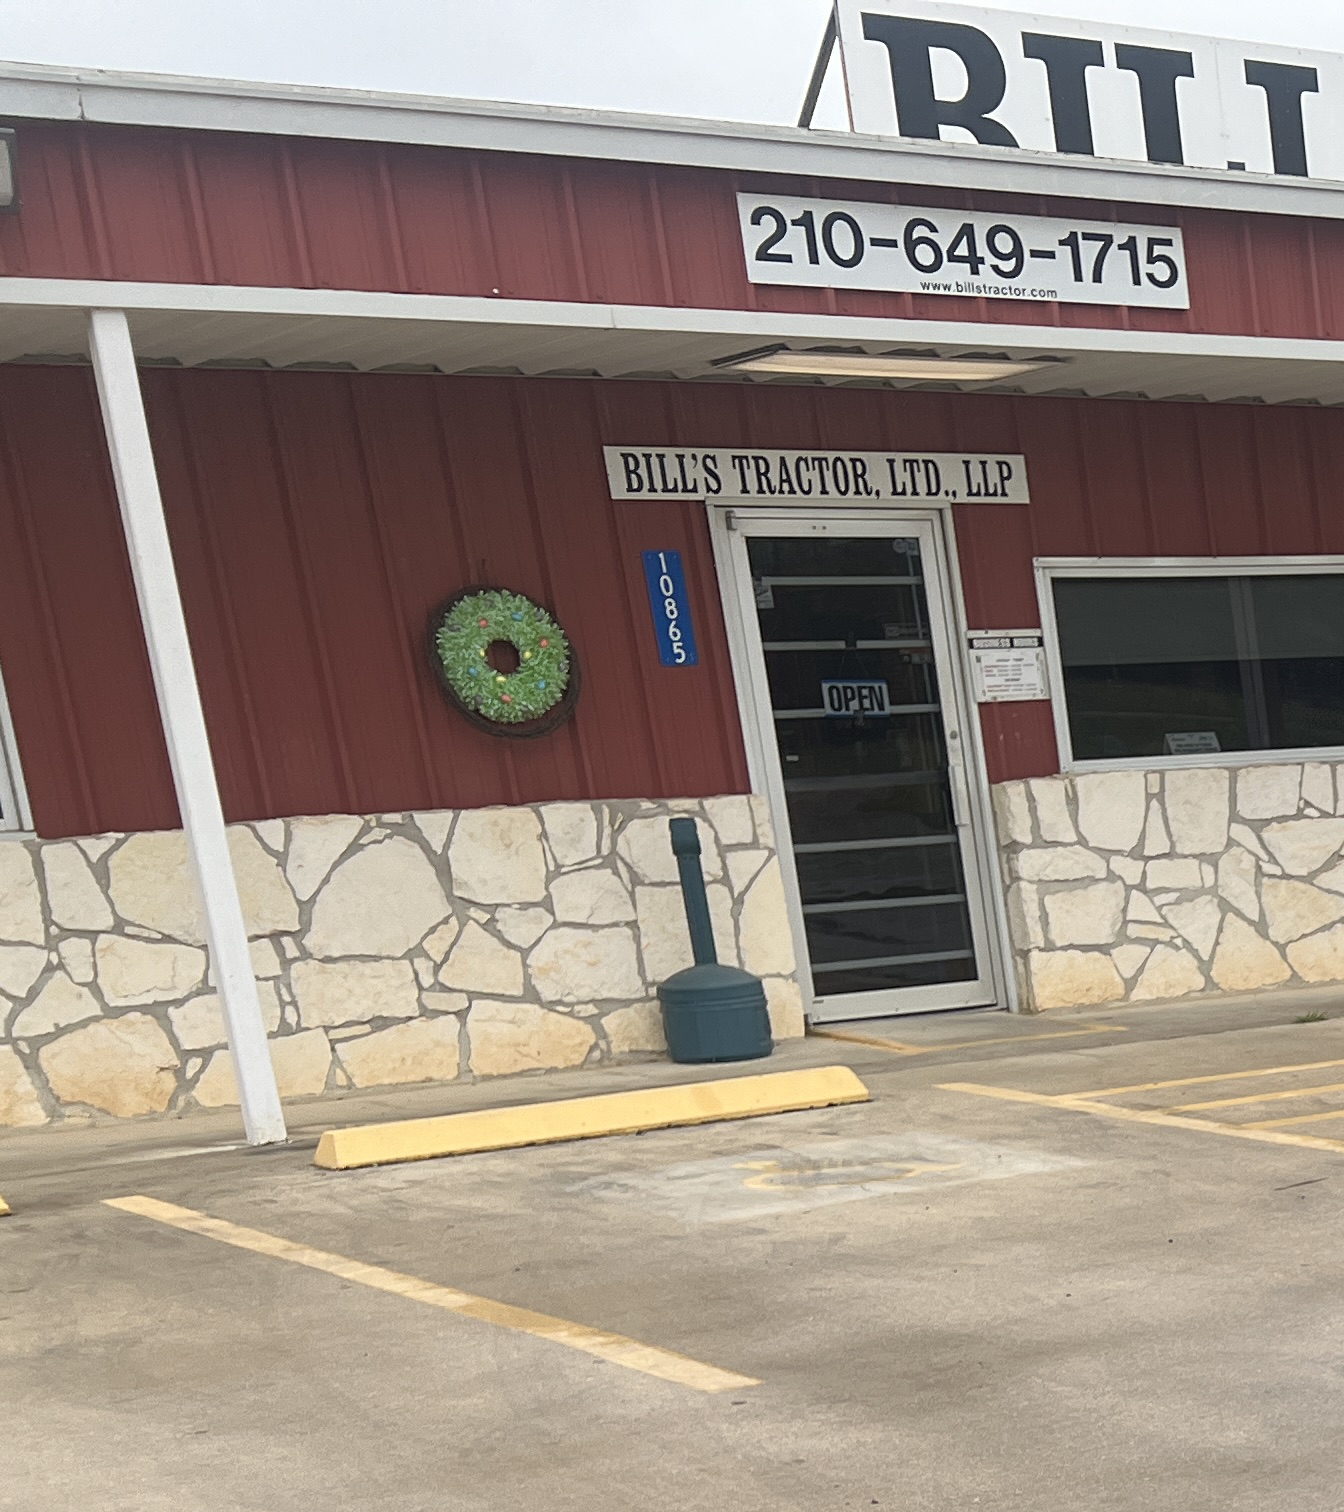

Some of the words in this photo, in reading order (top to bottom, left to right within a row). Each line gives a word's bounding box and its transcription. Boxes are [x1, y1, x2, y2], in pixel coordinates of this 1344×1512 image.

[749, 205, 1180, 290] 210-649-1715
[919, 279, 1059, 300] www.billstractor.com
[620, 451, 724, 496] BILL'S
[732, 454, 881, 500] TRACTOR,
[886, 457, 957, 501] LTD.,
[963, 459, 1014, 498] LLP
[655, 551, 688, 665] 10865
[827, 684, 887, 713] OPEN
